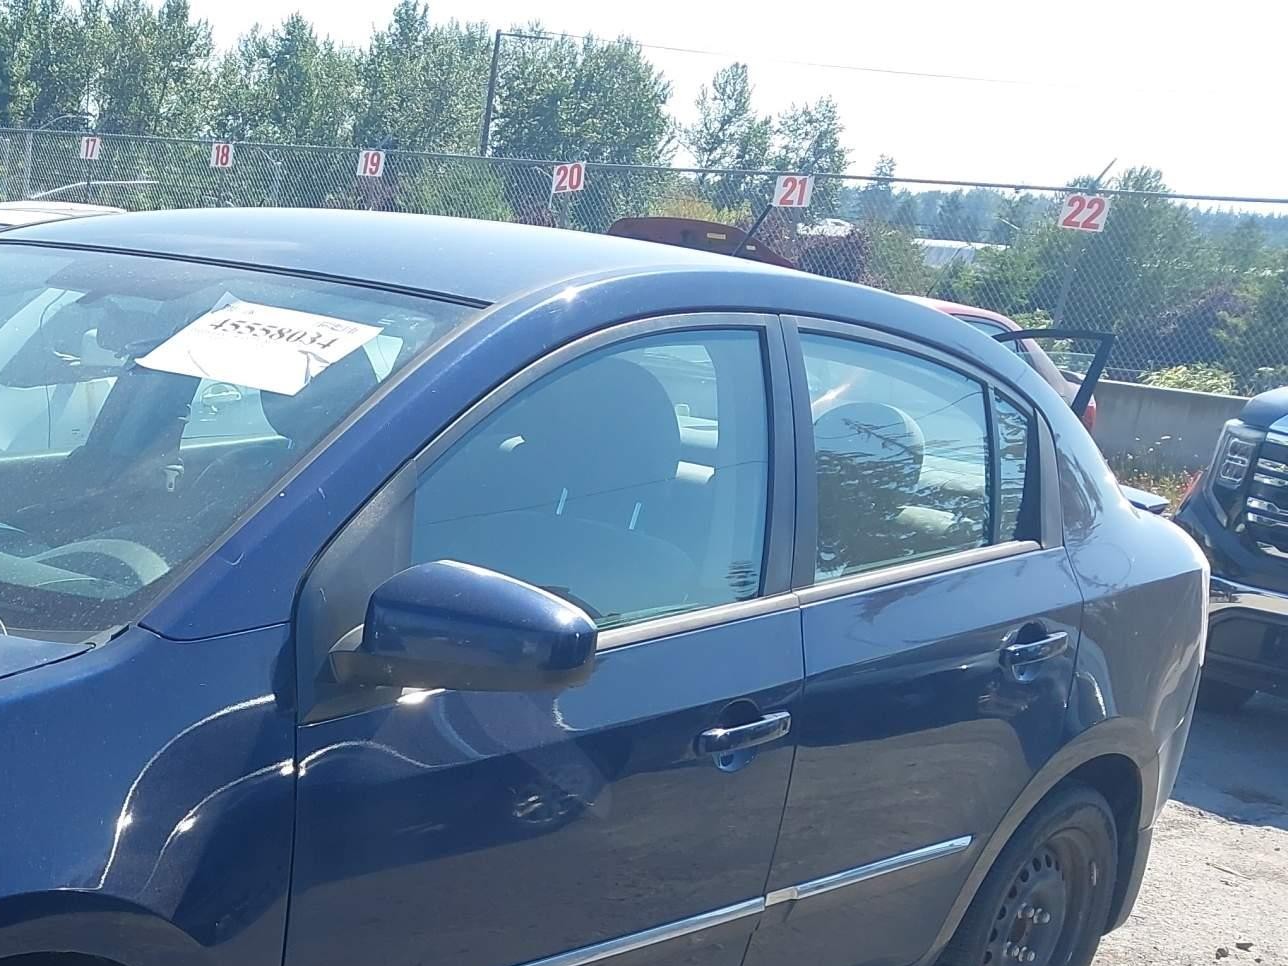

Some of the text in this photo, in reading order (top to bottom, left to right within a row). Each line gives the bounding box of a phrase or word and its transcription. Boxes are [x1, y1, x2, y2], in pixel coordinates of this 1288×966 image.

[84, 138, 96, 158] 17
[215, 145, 230, 166] 18
[362, 152, 381, 175] 19
[555, 164, 583, 191] 20
[779, 176, 807, 206] 21
[1062, 195, 1106, 229] 22
[209, 318, 339, 349] 45558034
